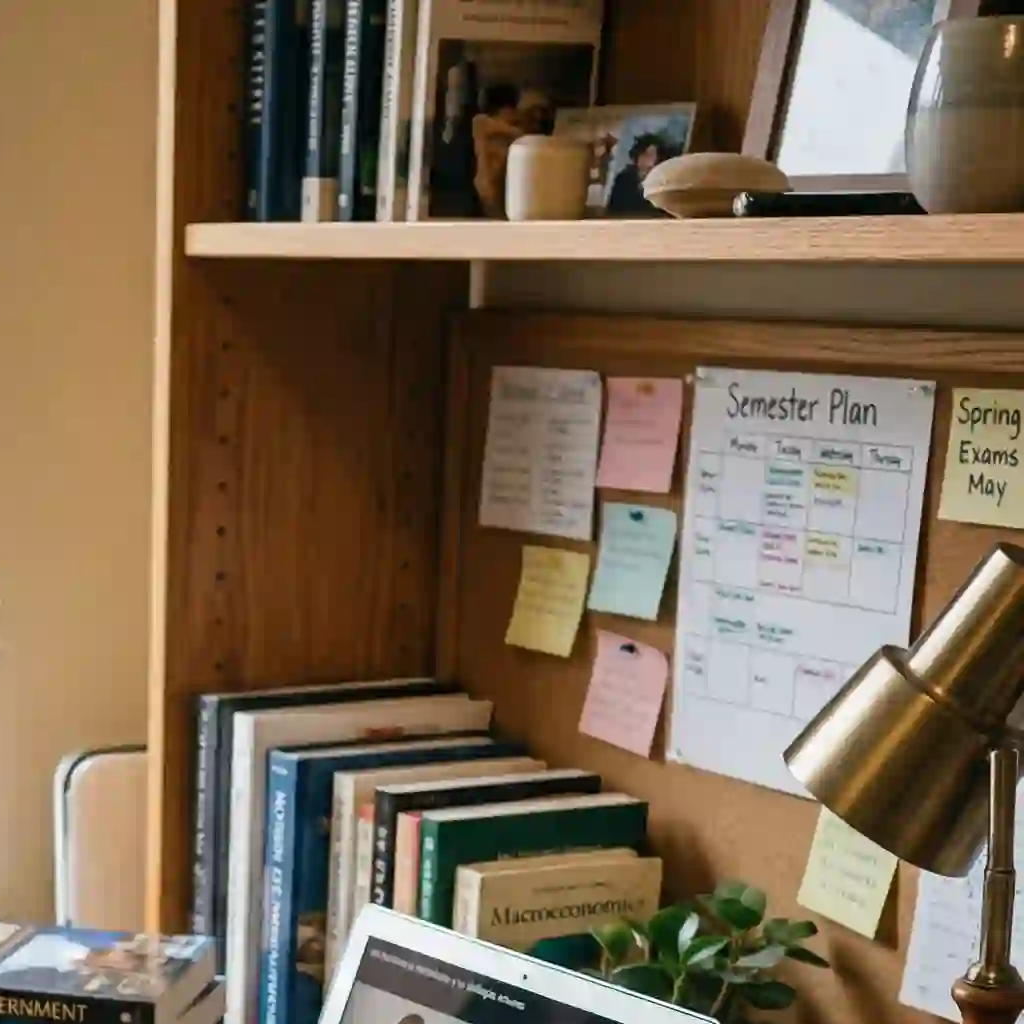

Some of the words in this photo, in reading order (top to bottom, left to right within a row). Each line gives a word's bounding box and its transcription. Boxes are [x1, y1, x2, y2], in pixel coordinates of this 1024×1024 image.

[726, 382, 820, 422] Semester
[829, 388, 879, 427] Plan
[958, 397, 1022, 440] Spring
[959, 440, 1020, 467] Exams
[968, 473, 1008, 507] May
